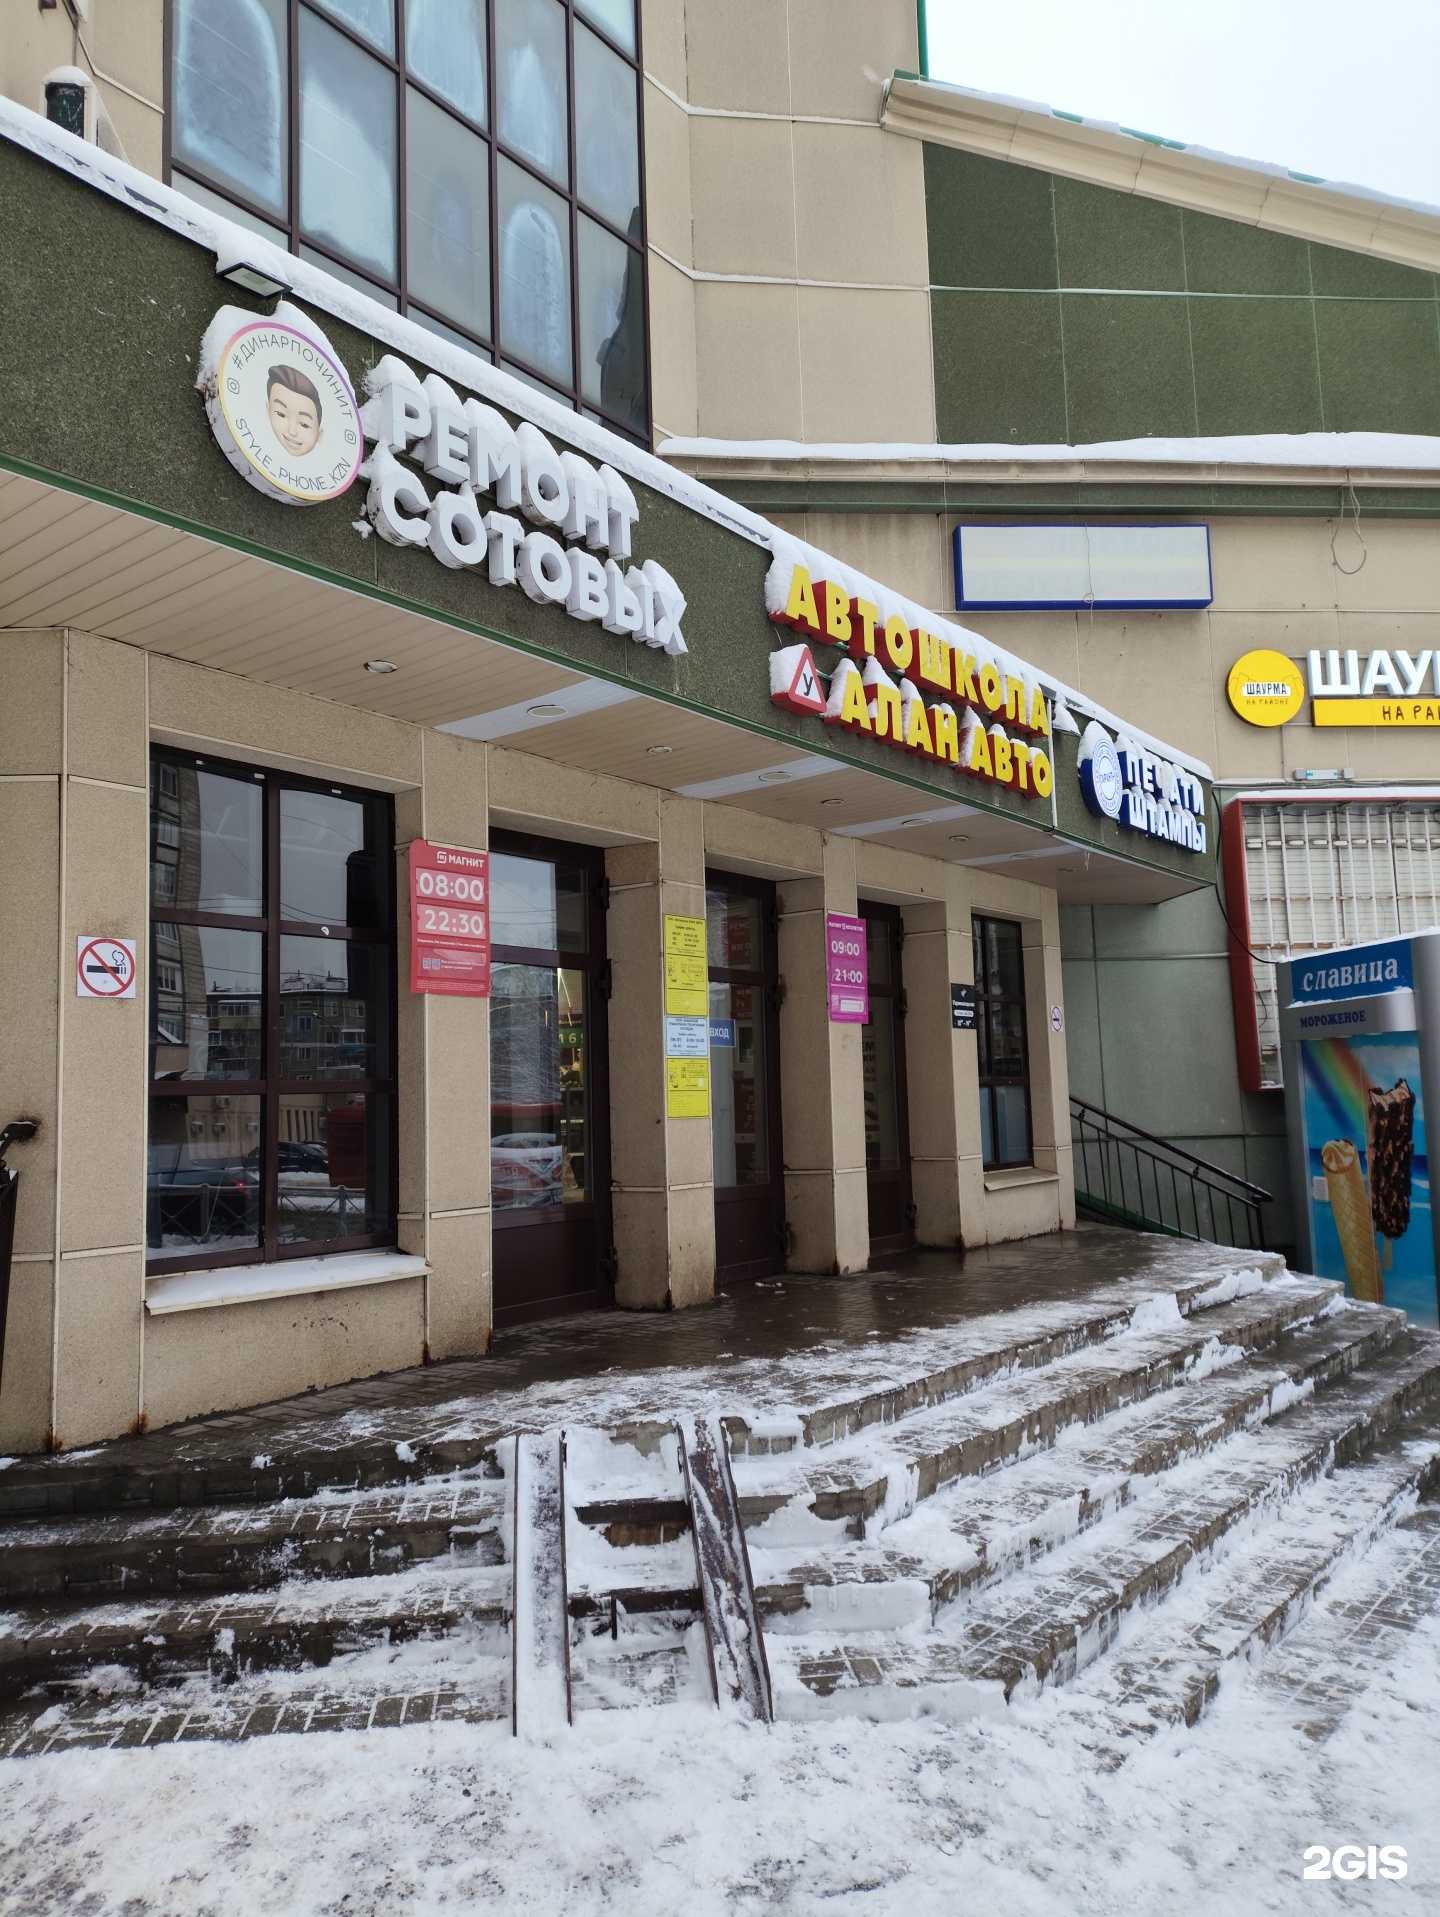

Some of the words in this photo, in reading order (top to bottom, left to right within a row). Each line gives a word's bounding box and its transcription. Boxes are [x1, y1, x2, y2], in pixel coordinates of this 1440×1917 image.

[232, 333, 354, 419] #ДИНАРПОЧИНИТ
[235, 417, 352, 491] STYLE_PHONE_KZN
[384, 374, 640, 560] РЕМОНТ
[368, 465, 689, 655] СОТОВЫХ
[785, 564, 1051, 737] АВТОШКОЛА
[1308, 649, 1440, 696] ШАУ
[1246, 683, 1287, 695] ШАУРМА
[1382, 705, 1404, 721] НА
[1413, 704, 1440, 721] РА
[839, 668, 959, 764] АЛАН
[970, 725, 1054, 799] АВТО
[1125, 749, 1205, 817] ПЕАТИ
[1128, 792, 1207, 854] ШТАМПЫ
[448, 853, 485, 868] МАГНИТ
[418, 872, 485, 901] 08:00
[424, 909, 485, 936] 22:30
[831, 940, 861, 956] 09:00
[834, 968, 863, 984] 21:00
[1300, 1010, 1367, 1029] МОРОЖЕНОЕ
